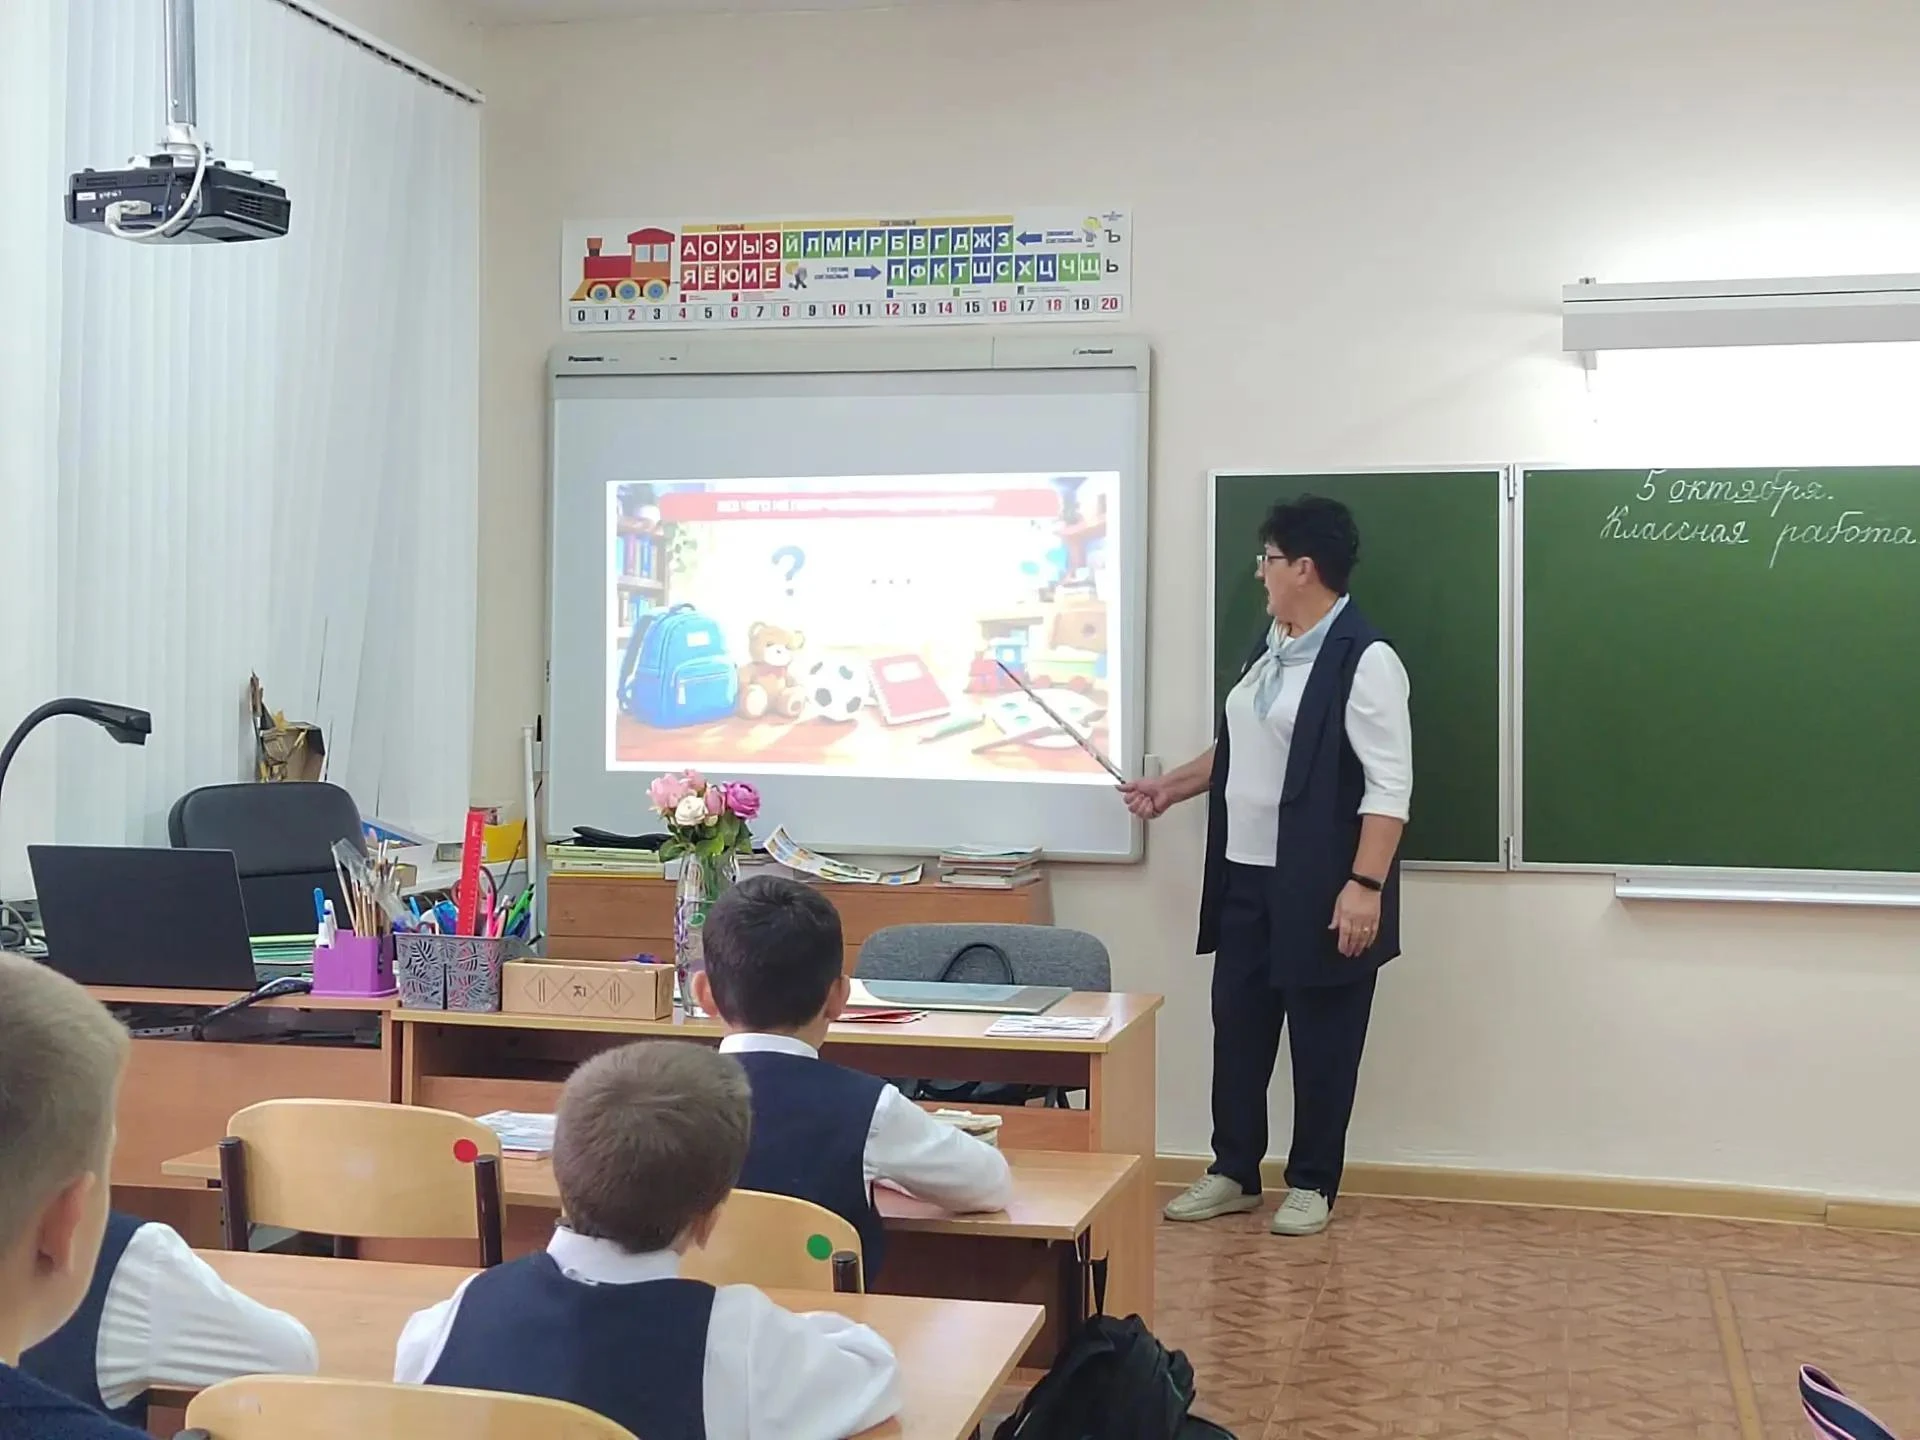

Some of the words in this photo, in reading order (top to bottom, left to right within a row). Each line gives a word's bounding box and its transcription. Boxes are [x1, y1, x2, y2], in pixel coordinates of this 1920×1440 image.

[683, 241, 697, 256] А
[703, 240, 718, 256] О
[724, 239, 737, 255] У
[743, 239, 760, 255] Ы
[765, 238, 778, 254] Э
[785, 234, 799, 253] Й
[806, 237, 820, 253] Л
[826, 236, 841, 252] М
[848, 236, 862, 252] Н
[870, 236, 883, 252] Р
[891, 235, 905, 251] Б
[912, 235, 926, 251] В
[934, 234, 946, 250] Г
[953, 233, 969, 252] Д
[973, 232, 992, 248] Ж
[997, 231, 1010, 248] З
[1104, 229, 1121, 244] Ъ
[683, 269, 696, 284] Я
[703, 265, 716, 284] Ё
[721, 268, 739, 284] Ю
[744, 268, 757, 283] И
[764, 267, 777, 283] Е
[890, 264, 904, 281] П
[910, 264, 927, 279] Ф
[933, 263, 946, 279] К
[954, 262, 967, 278] Т
[973, 261, 991, 277] Ш
[996, 261, 1010, 277] С
[1018, 260, 1032, 276] Х
[1039, 260, 1054, 278] Ц
[1061, 259, 1075, 275] Ч
[1080, 258, 1101, 276] Щ
[577, 310, 586, 322] 0
[604, 309, 609, 321] 1
[628, 308, 636, 321] 2
[653, 308, 661, 320] 3
[679, 307, 687, 319] 4
[704, 306, 713, 319] 5
[730, 306, 739, 318] 6
[757, 305, 764, 318] 7
[782, 305, 790, 317] 8
[808, 304, 817, 317] 9
[832, 303, 846, 316] 10
[858, 303, 871, 316] 11
[885, 303, 900, 316] 12
[912, 302, 927, 315] 13
[938, 301, 953, 314] 14
[965, 300, 980, 314] 15
[992, 300, 1007, 313] 16
[1020, 299, 1035, 312] 17
[1047, 298, 1062, 311] 18
[1074, 298, 1090, 311] 19
[1101, 297, 1118, 310] 20
[1637, 470, 1667, 501] 5
[1600, 505, 1750, 544] Классная
